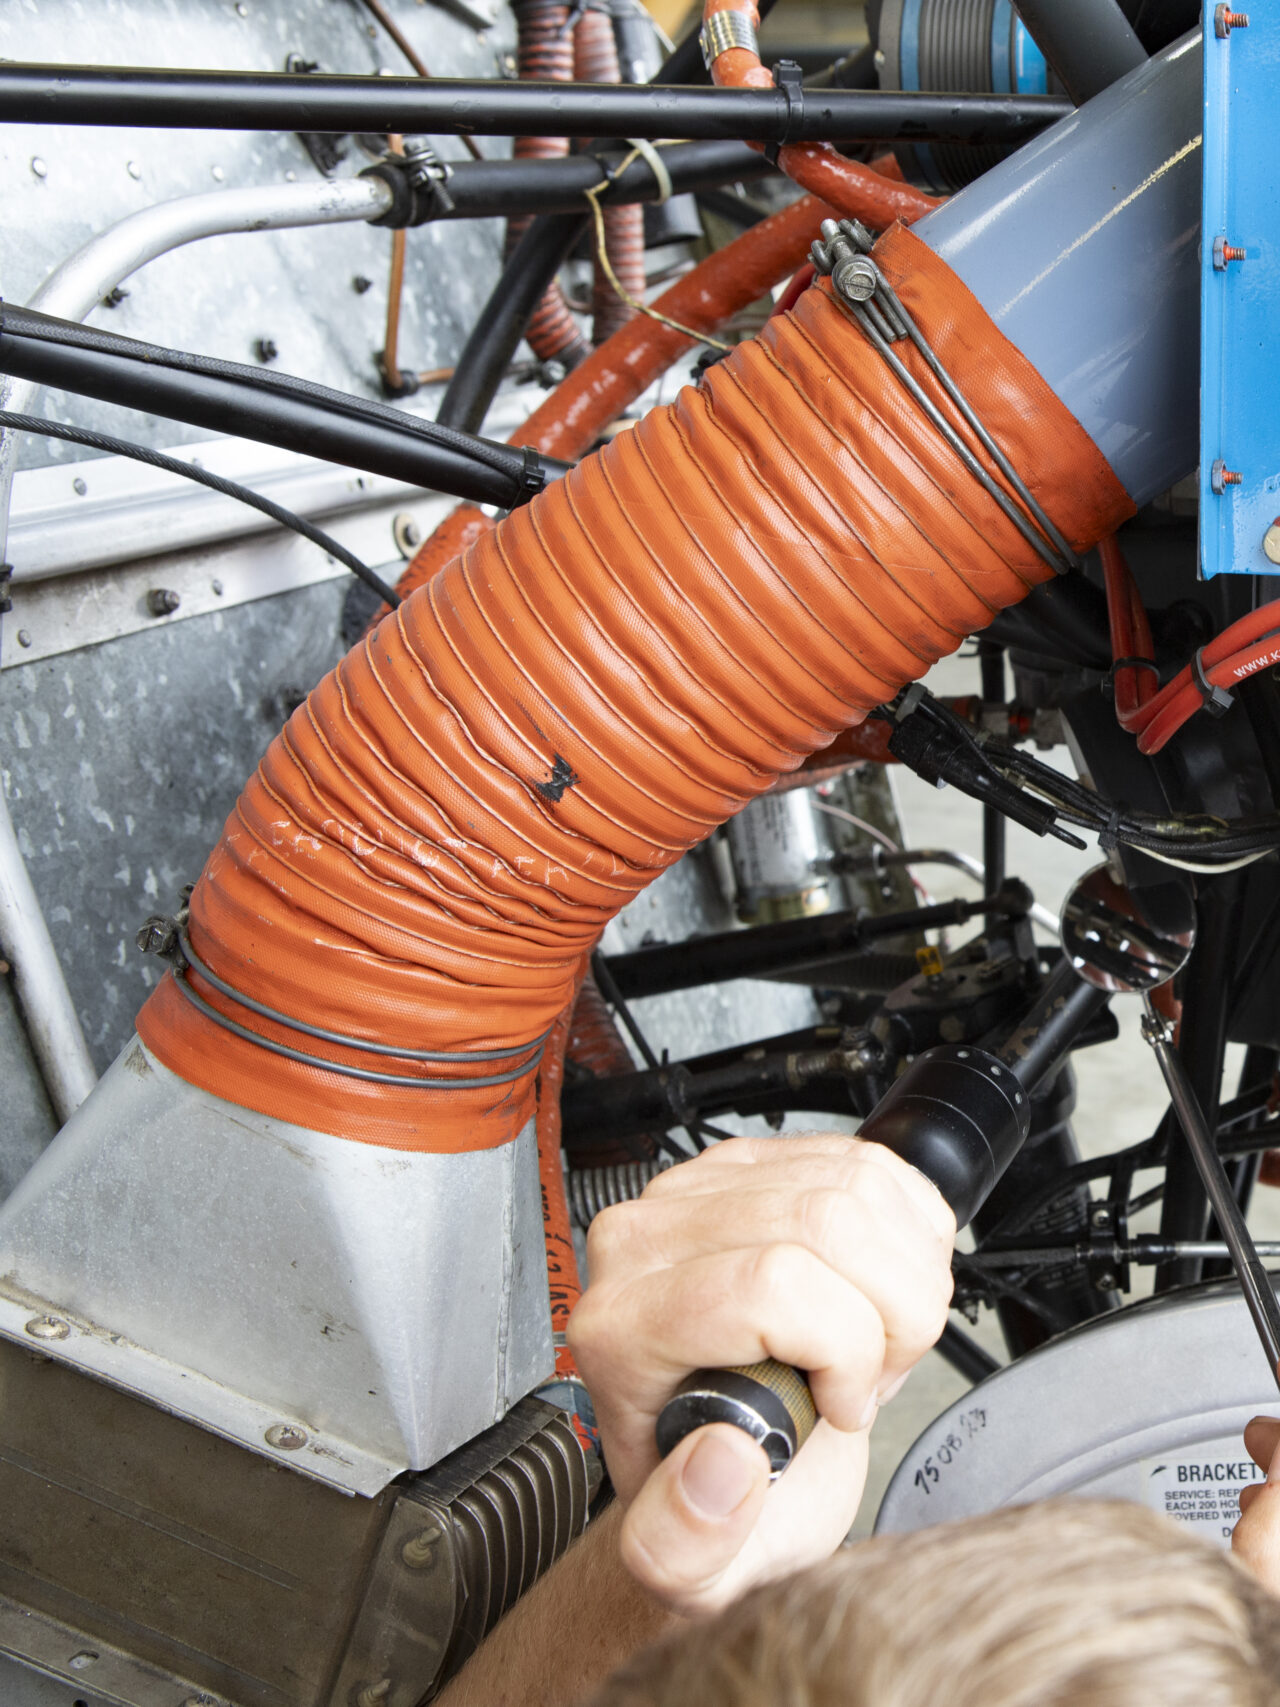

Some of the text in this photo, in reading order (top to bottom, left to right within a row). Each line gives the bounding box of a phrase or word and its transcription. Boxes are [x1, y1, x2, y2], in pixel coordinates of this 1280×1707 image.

[1164, 1488, 1241, 1501] SERVICE: REP
[1165, 1501, 1196, 1511] EACH
[1199, 1500, 1217, 1510] 200
[1223, 1510, 1242, 1520] WIT
